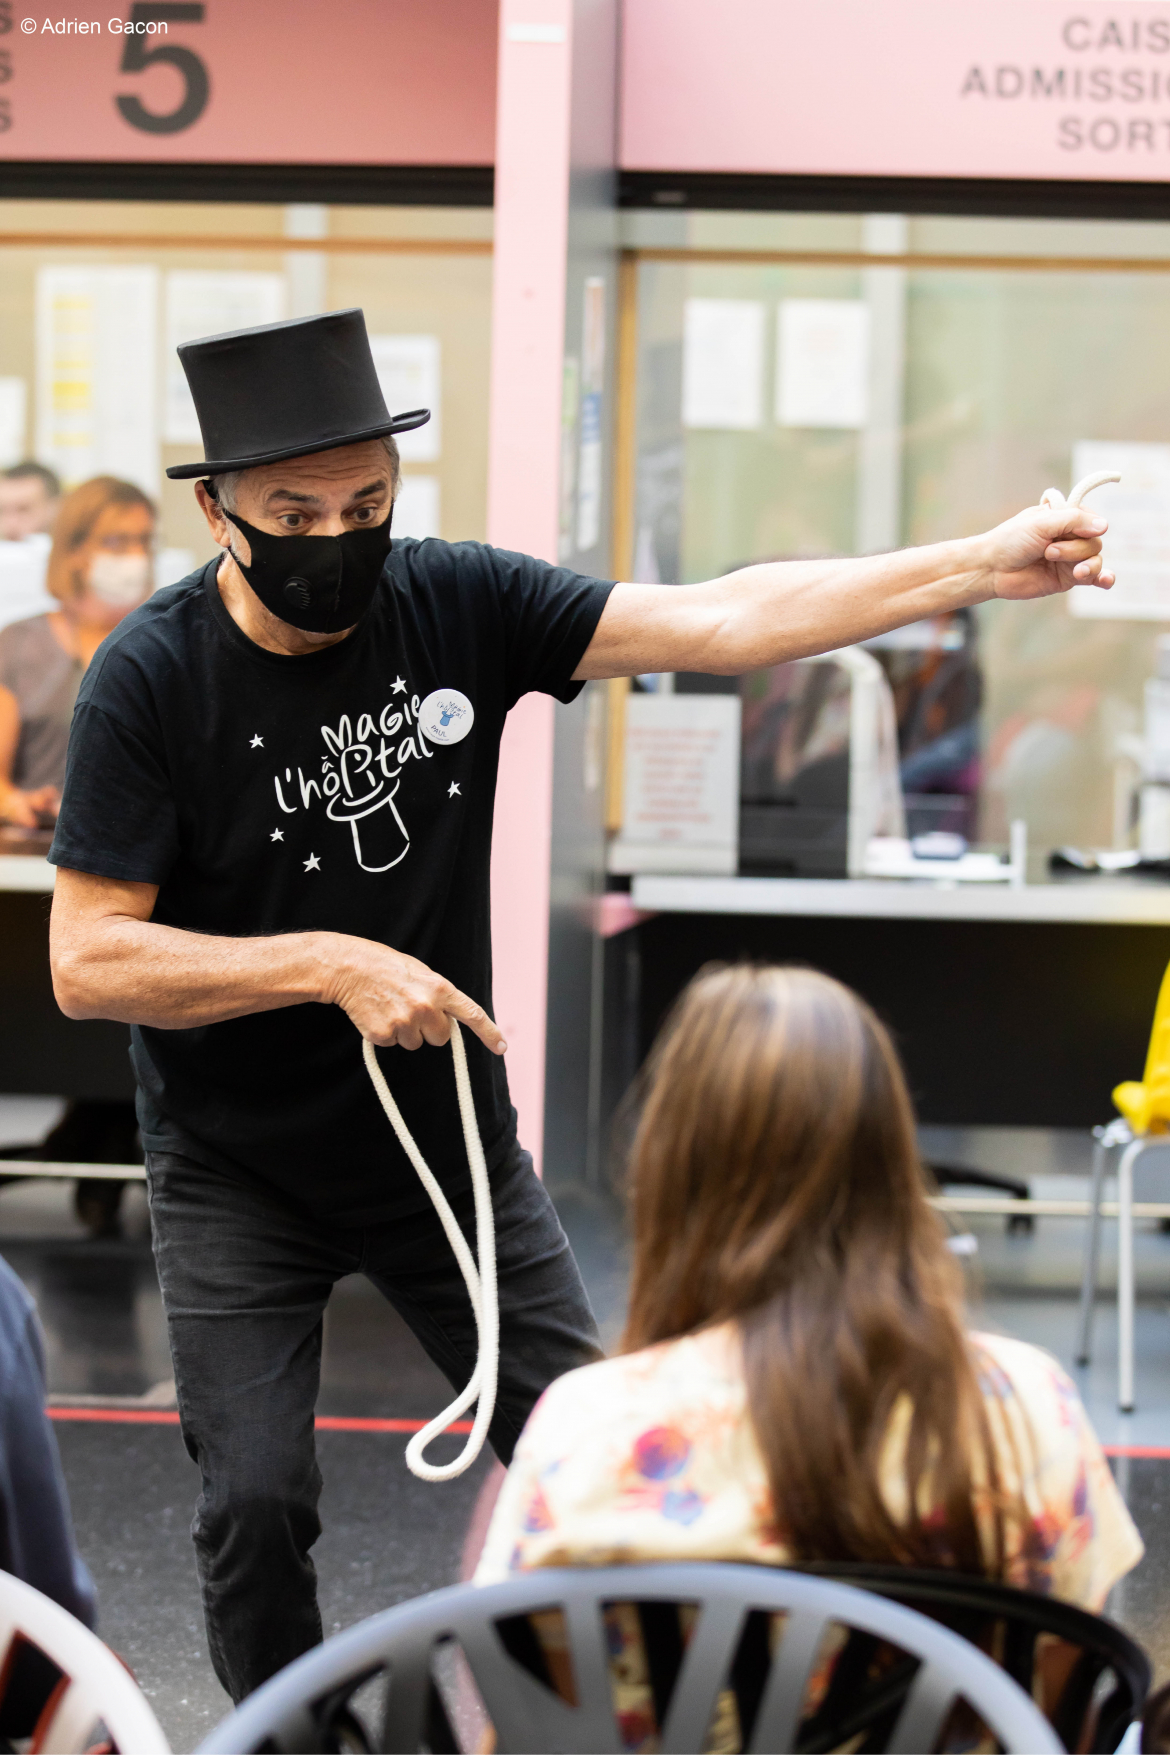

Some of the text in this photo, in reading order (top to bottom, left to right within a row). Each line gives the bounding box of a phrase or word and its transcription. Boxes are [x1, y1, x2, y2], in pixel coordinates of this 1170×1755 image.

[116, 2, 211, 136] 5
[961, 65, 1170, 102] ADMISSI
[430, 724, 447, 738] PAUL
